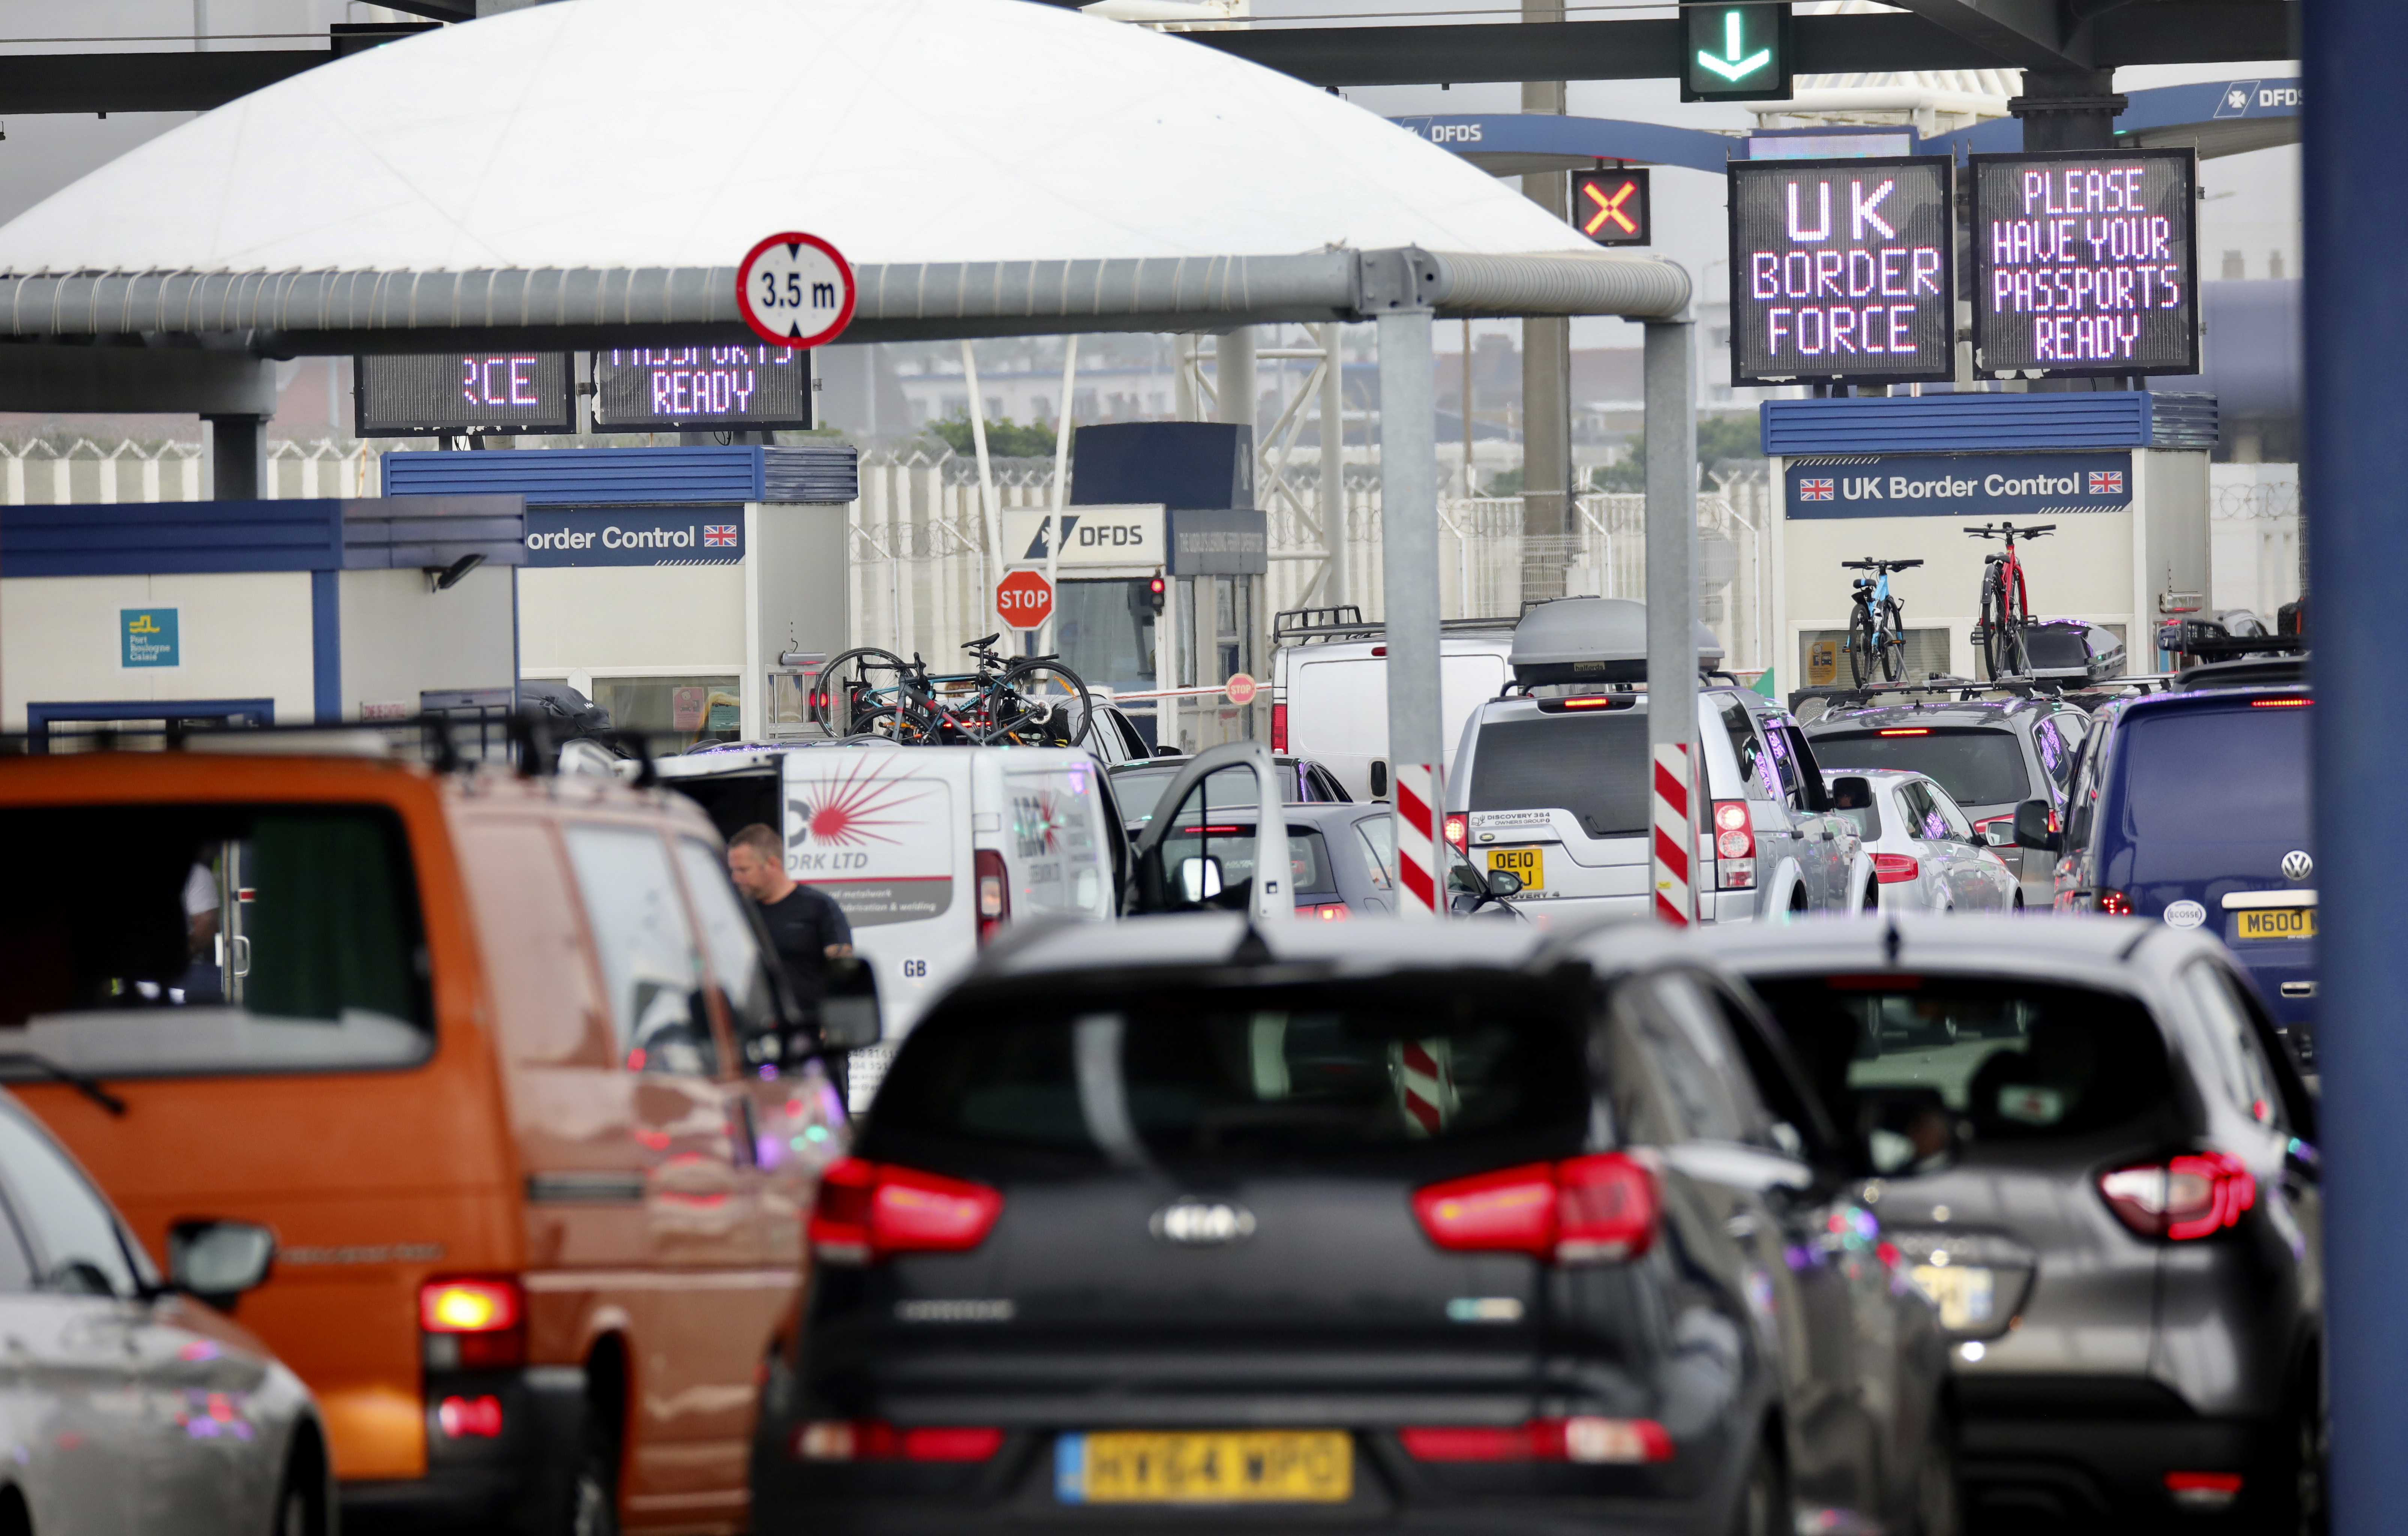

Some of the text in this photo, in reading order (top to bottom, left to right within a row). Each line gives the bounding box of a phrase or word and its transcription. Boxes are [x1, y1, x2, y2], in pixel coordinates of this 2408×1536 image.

[1431, 124, 1482, 142] DFDS
[2024, 169, 2145, 215] PLEASE
[1787, 181, 1895, 242] UK
[1993, 216, 2171, 265] HAVE YOUR
[1753, 247, 1940, 300] BORDER
[761, 271, 835, 308] 3.5 m
[1994, 265, 2179, 314] PASSPORTS
[1769, 305, 1917, 356] FORCE
[2036, 314, 2139, 361] READY
[652, 369, 755, 414] READY
[1843, 472, 2080, 500] UK Border Control
[525, 525, 695, 550] order Control
[1079, 525, 1143, 547] DFDS
[1000, 589, 1049, 609] STOP
[130, 635, 147, 644] Port
[1230, 684, 1251, 695] STOP
[832, 852, 869, 870] LTD
[842, 888, 892, 898] metalwork
[889, 902, 897, 911] &
[899, 901, 937, 913] welding
[2169, 910, 2199, 919] ECOSSE
[2247, 913, 2303, 933] M600
[904, 960, 926, 977] GB
